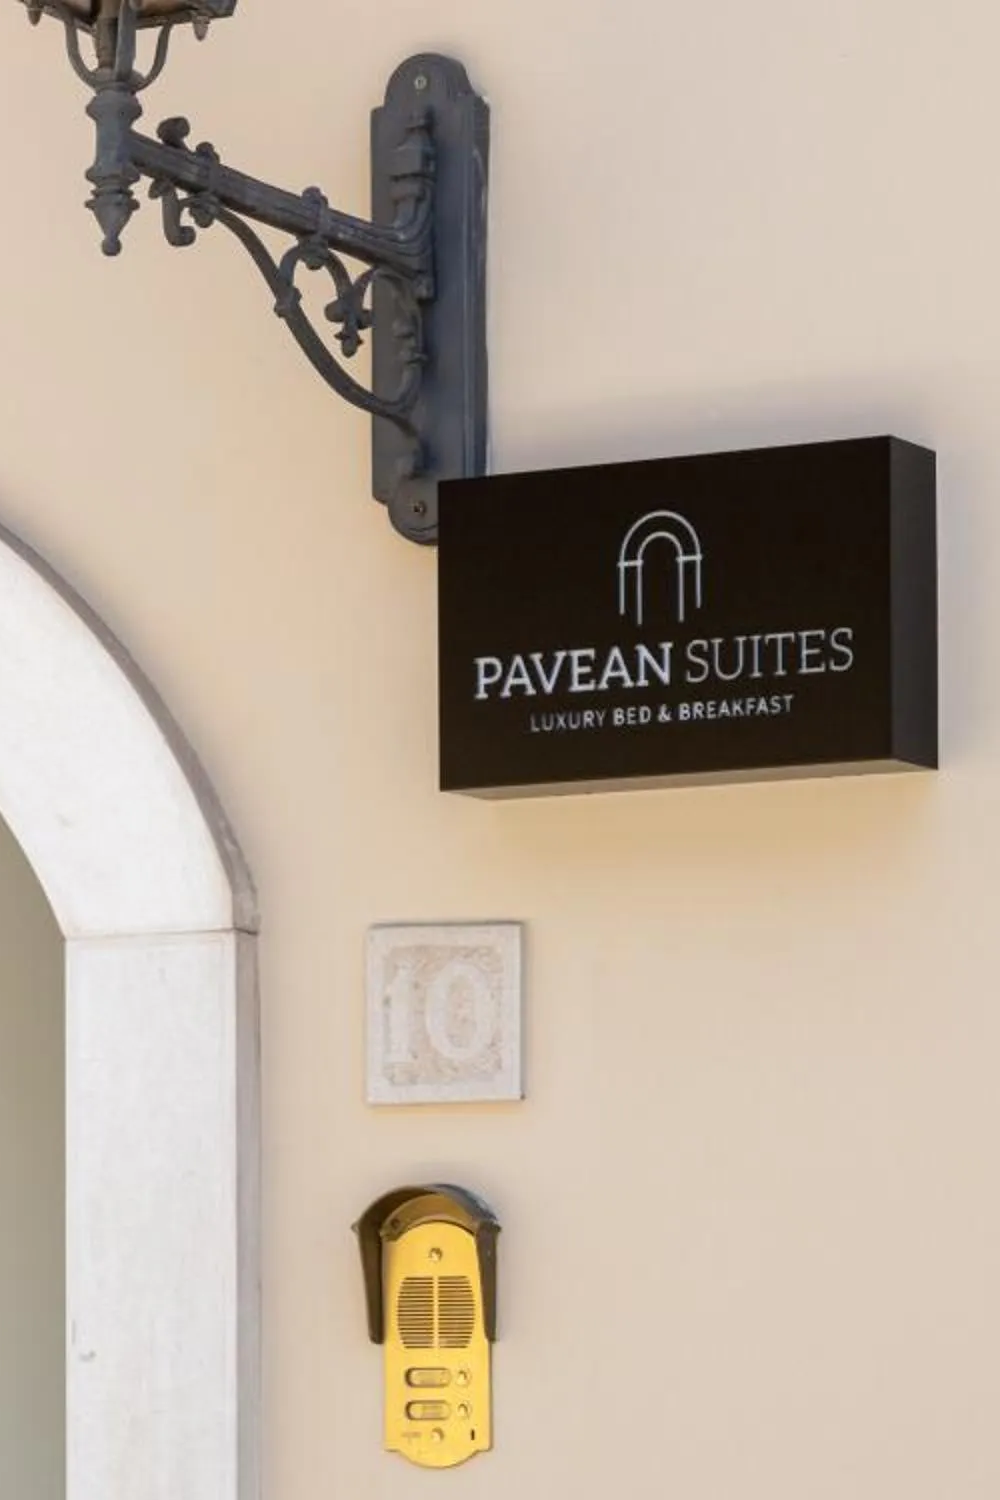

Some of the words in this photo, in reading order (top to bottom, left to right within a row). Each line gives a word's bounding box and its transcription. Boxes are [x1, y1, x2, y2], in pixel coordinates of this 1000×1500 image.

[474, 641, 674, 700] PAVEAN
[686, 627, 854, 684] SUITES
[530, 709, 606, 733] LUXURY
[612, 705, 652, 726] BED
[657, 703, 672, 723] &
[678, 694, 794, 721] BREAKFAST
[386, 960, 495, 1062] 10
